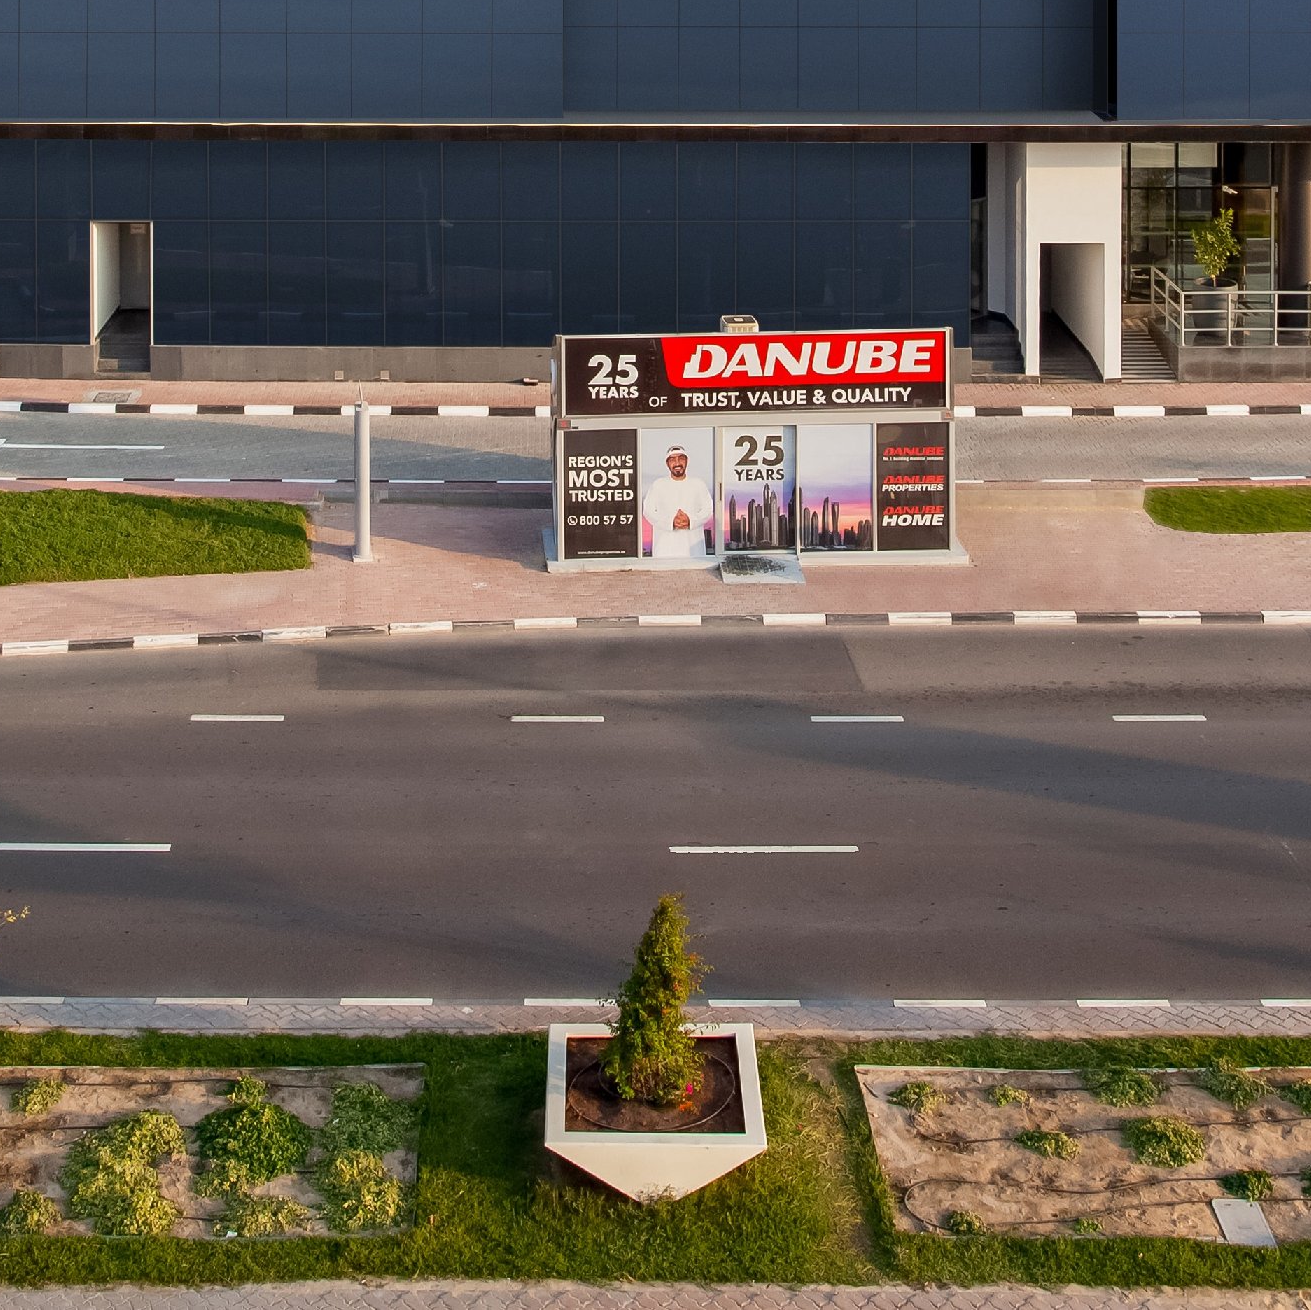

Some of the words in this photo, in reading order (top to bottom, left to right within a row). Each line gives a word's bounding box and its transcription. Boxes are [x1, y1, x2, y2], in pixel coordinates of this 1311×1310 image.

[683, 339, 936, 379] DANUBE
[588, 354, 639, 386] 25
[588, 386, 639, 399] YEARS
[648, 396, 668, 408] OF
[681, 391, 742, 409] TRUST,
[747, 390, 807, 407] VALUE
[812, 388, 827, 405] &
[831, 387, 912, 404] QUALITY
[734, 435, 785, 466] 25
[883, 446, 946, 456] DANUBE
[569, 455, 634, 468] REGION'S
[568, 469, 634, 488] MOST
[734, 469, 785, 481] YEARS
[883, 475, 945, 484] DANUBE
[882, 483, 944, 492] PROPERTIES
[569, 490, 634, 502] TRUSTED
[883, 505, 944, 515] DANUBE
[579, 515, 600, 525] 800
[603, 515, 616, 525] 57
[620, 514, 634, 525] 57
[882, 513, 945, 527] HOME
